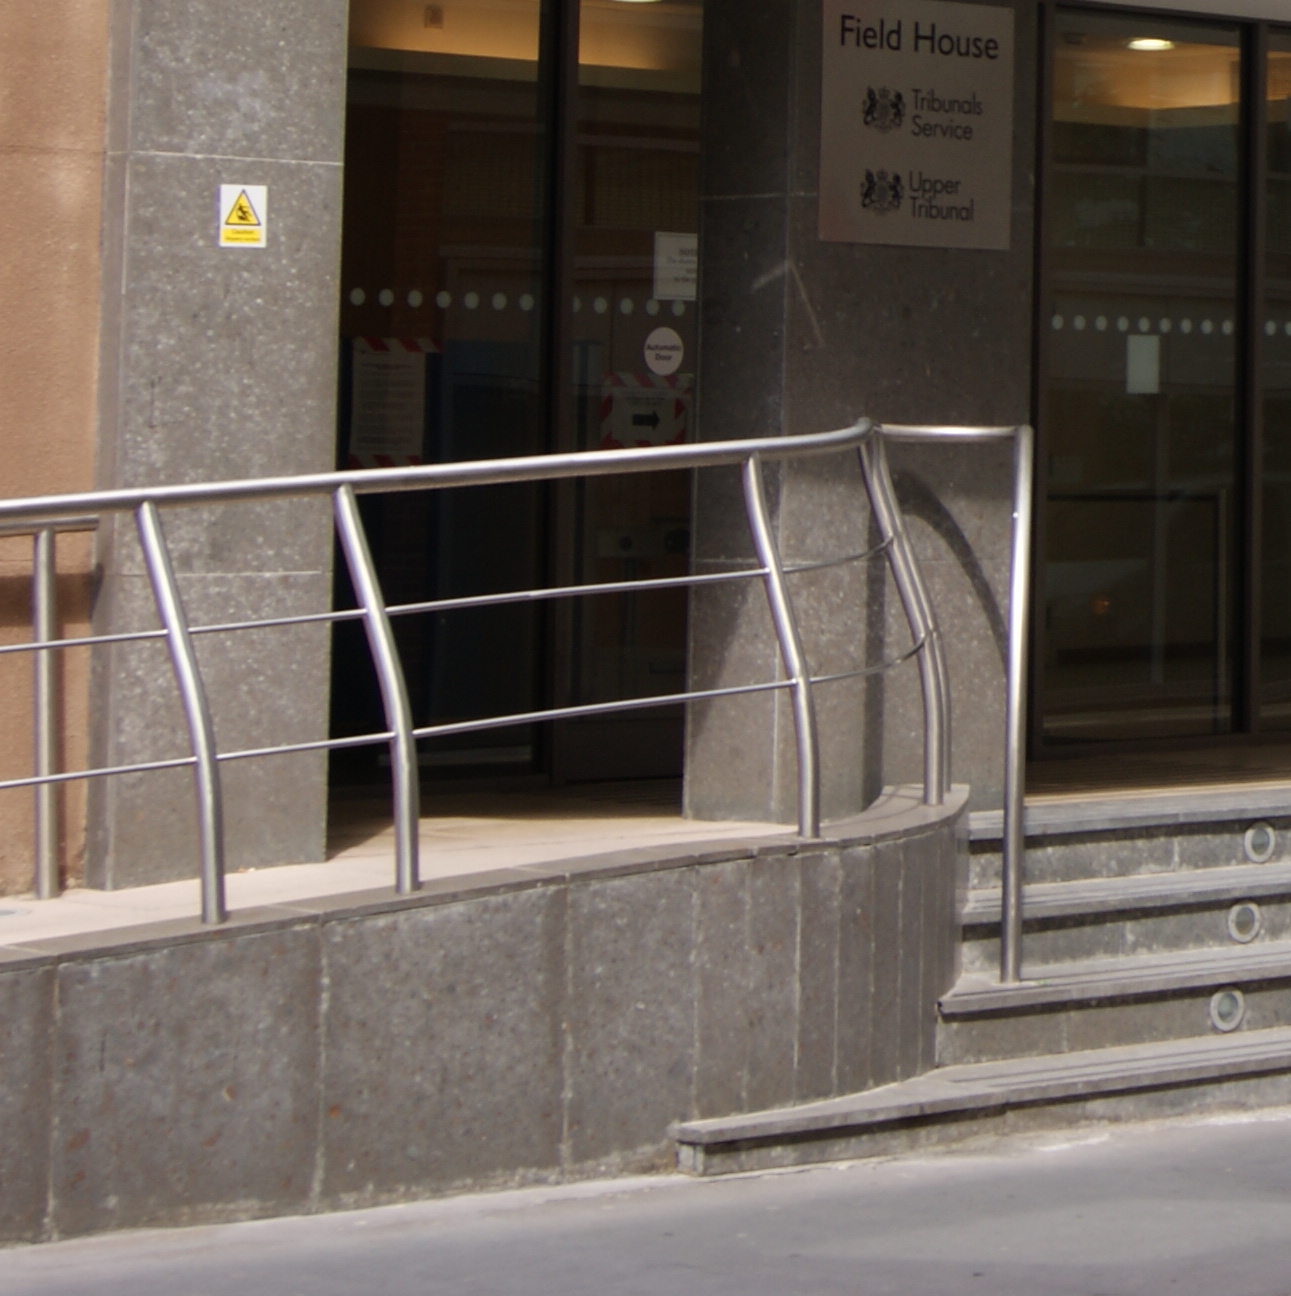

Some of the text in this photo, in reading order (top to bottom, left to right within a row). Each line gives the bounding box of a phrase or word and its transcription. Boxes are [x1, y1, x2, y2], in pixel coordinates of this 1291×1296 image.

[840, 14, 1000, 59] Field House
[911, 87, 984, 115] Tribunals
[911, 115, 973, 140] Service
[908, 170, 961, 197] Upper
[910, 196, 975, 221] Tribunal
